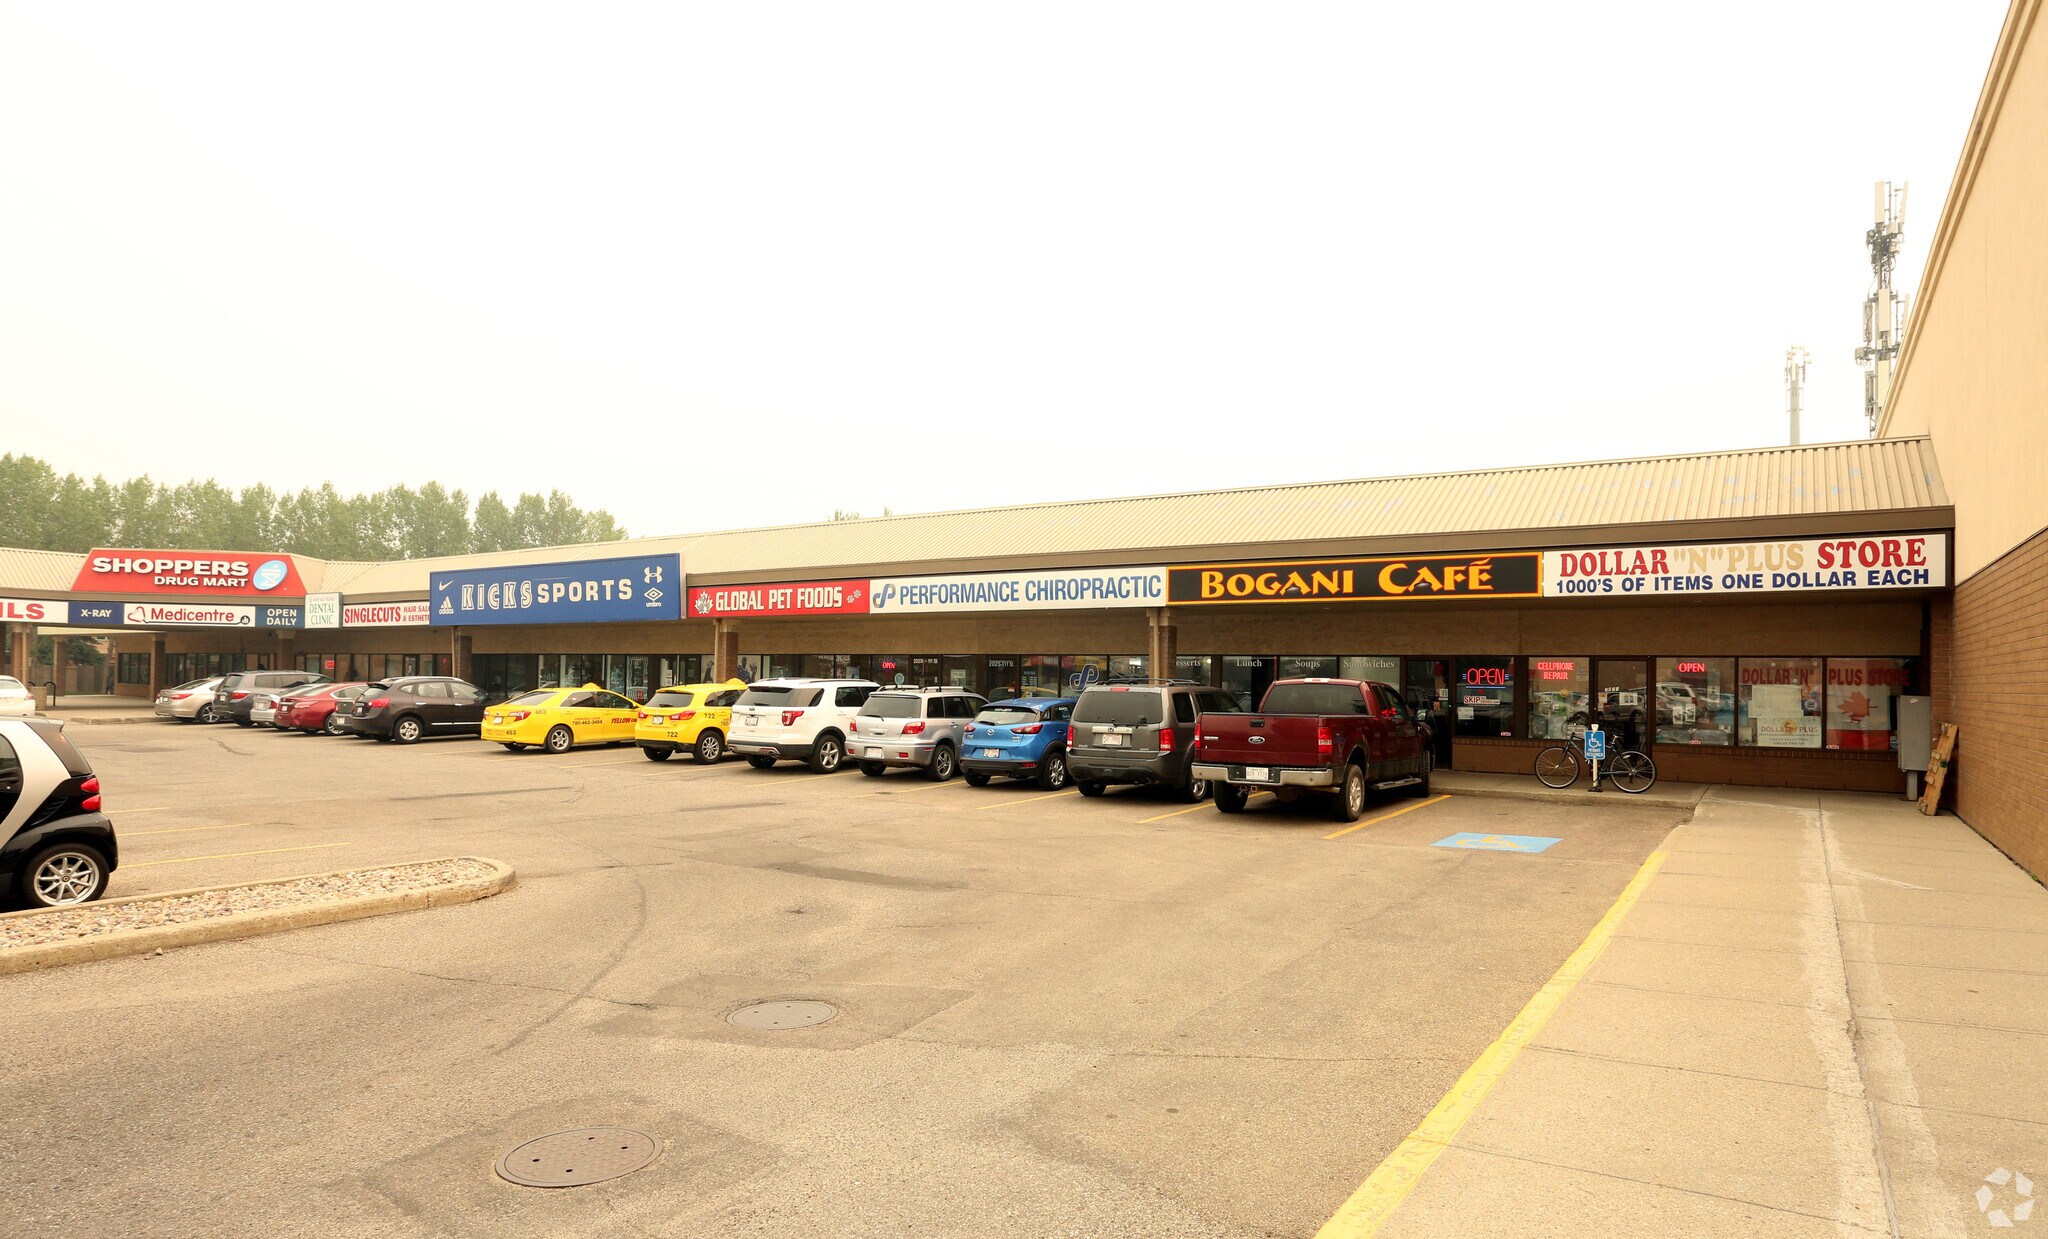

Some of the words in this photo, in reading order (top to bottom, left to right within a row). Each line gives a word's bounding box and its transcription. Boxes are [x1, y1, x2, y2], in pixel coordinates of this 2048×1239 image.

[1560, 549, 1669, 577] DOLLAR
[1674, 546, 1724, 574] "N"
[1727, 543, 1804, 573] PLUS
[1818, 538, 1926, 569] STORE
[92, 557, 249, 576] SHOPPERS
[154, 576, 198, 586] DRUG
[203, 578, 248, 587] MART
[1201, 569, 1354, 598] BOGANI
[1557, 578, 1613, 594] 1000'S
[1622, 577, 1646, 592] OF
[1654, 576, 1713, 590] ITEMS
[1722, 574, 1764, 589] ONE
[1772, 571, 1856, 588] DOLLAR
[1868, 569, 1928, 586] EACH
[461, 580, 532, 610] KICKS
[538, 578, 632, 604] SPORTS
[900, 581, 1020, 605] PERFORMANCE
[1025, 575, 1162, 601] CHIROPRACTIC
[716, 590, 764, 611] GLOBAL
[768, 588, 792, 610] PET
[797, 586, 842, 608] FOODS
[80, 609, 112, 618] X-RAY
[267, 608, 297, 617] OPEN
[310, 603, 334, 614] DENTAL
[151, 608, 234, 622] Medicentre
[310, 614, 334, 625] CLINIC
[344, 606, 401, 624] SINGLECUTS
[266, 618, 296, 626] DAILY
[1236, 659, 1262, 667] Lunch
[1294, 659, 1320, 668] Soups
[1343, 659, 1395, 668] Sandwiches
[1537, 662, 1574, 671] CELLPHONE
[1678, 663, 1705, 672] OPEN
[1467, 668, 1504, 685] OPEN
[1543, 672, 1568, 680] REPAIR
[1742, 668, 1790, 685] DOLLAR
[1828, 668, 1862, 686] PLUS
[1868, 668, 1911, 686] STORE
